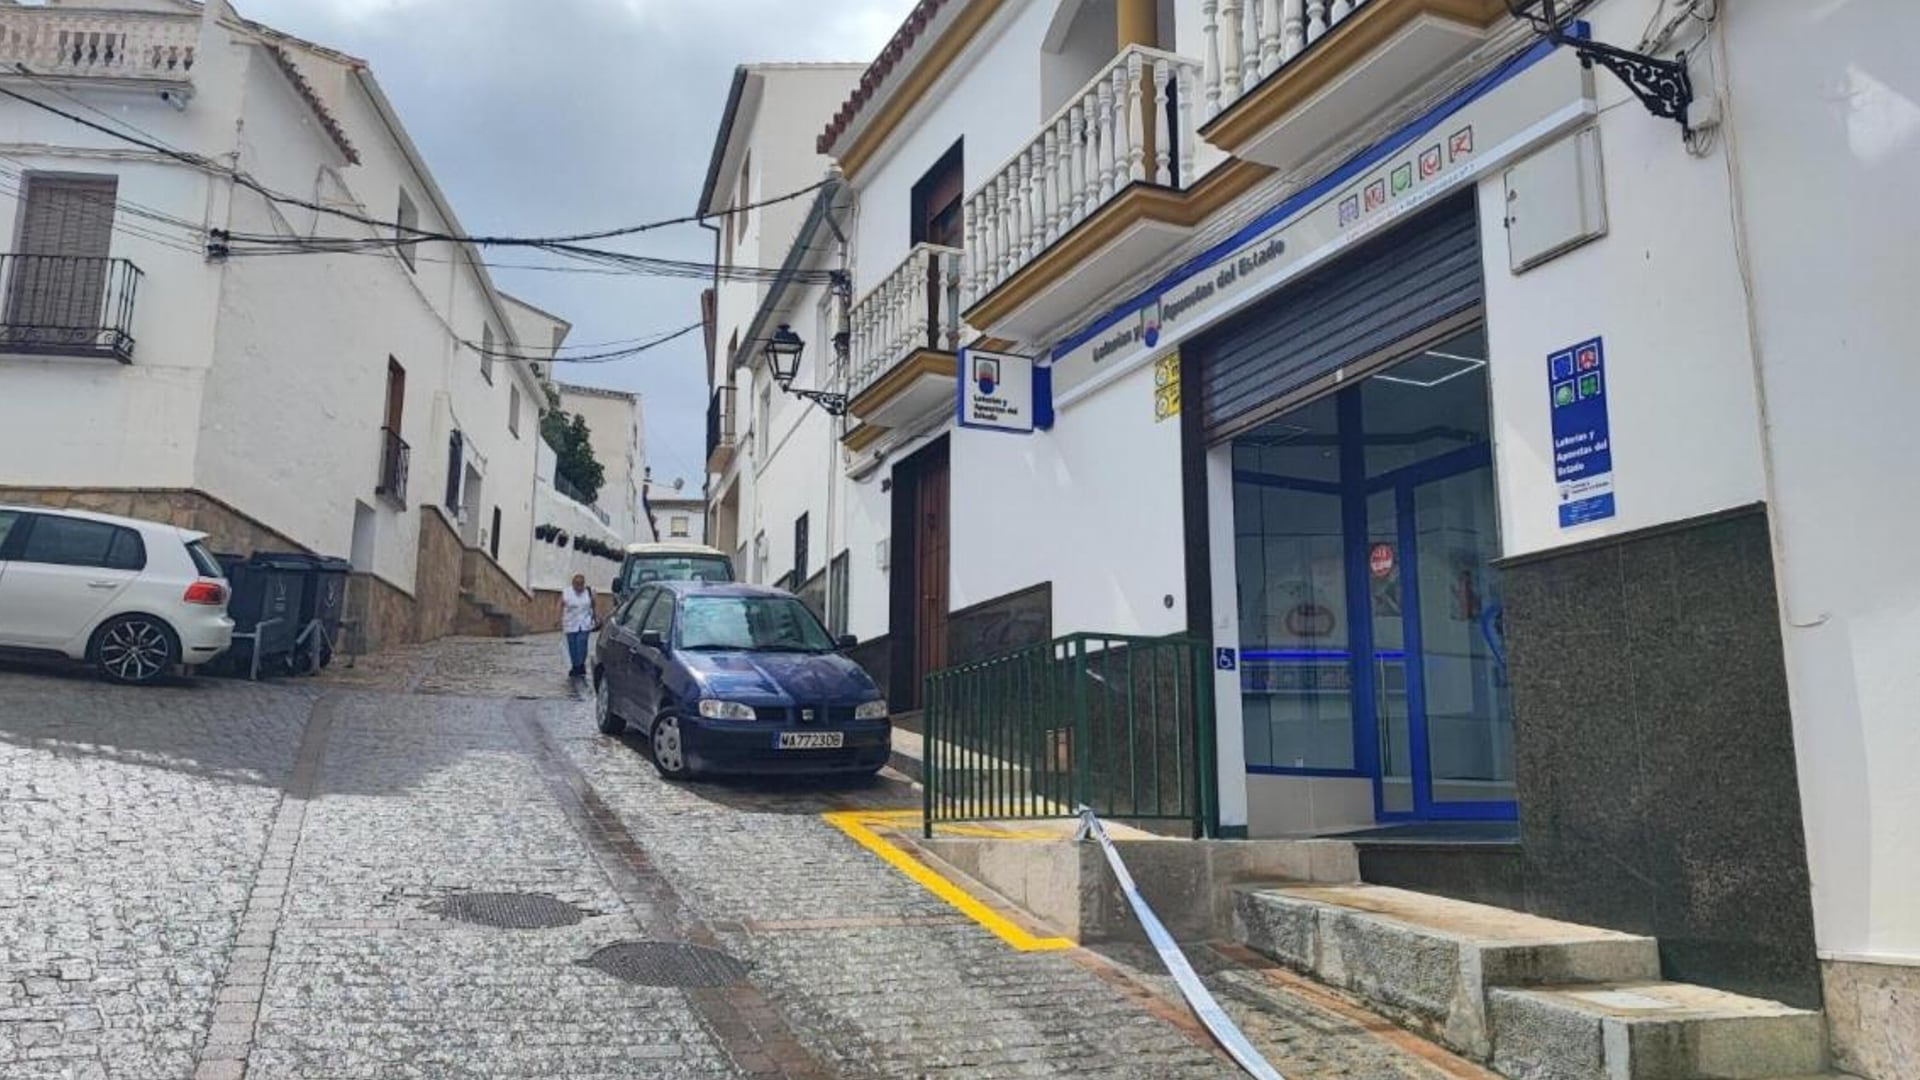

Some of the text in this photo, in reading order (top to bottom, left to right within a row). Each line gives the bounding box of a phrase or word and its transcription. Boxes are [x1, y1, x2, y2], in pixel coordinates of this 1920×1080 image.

[1162, 281, 1214, 321] Apuestas
[1217, 263, 1236, 289] del
[1238, 239, 1285, 276] Estado
[974, 403, 1006, 414] Apuestas
[974, 411, 998, 421] Estado
[1556, 438, 1607, 462] Apuestas del
[1558, 462, 1585, 477] Estado
